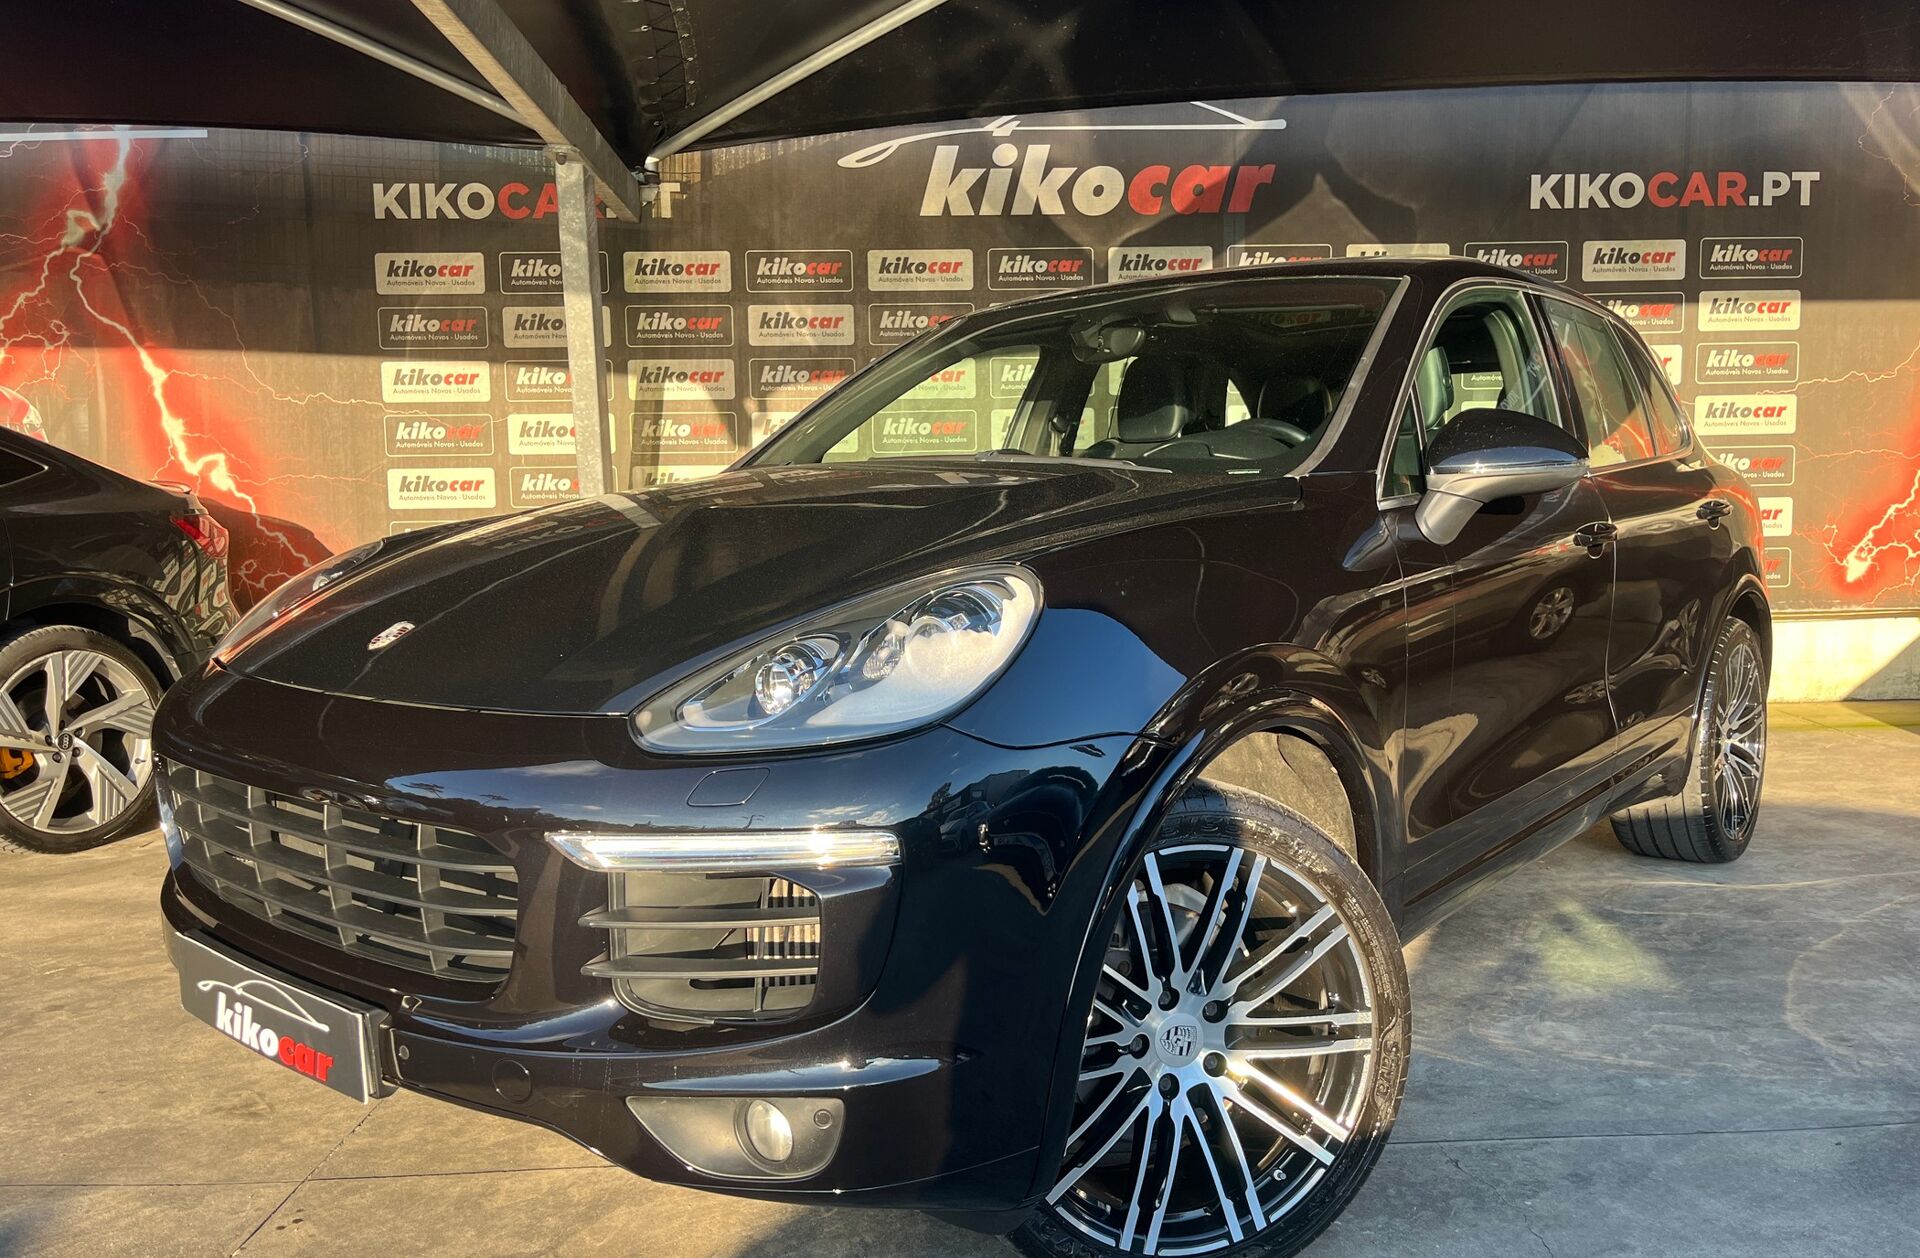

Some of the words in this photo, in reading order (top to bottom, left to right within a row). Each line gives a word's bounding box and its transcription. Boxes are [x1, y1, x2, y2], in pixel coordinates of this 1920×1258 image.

[920, 142, 1276, 216] kikocar
[1530, 171, 1820, 210] KIKOCAR.PT
[372, 182, 681, 220] KIKOCA.T
[1592, 247, 1676, 266] kikocar
[1710, 244, 1793, 262] kikocar
[386, 260, 474, 278] kikocar
[510, 258, 562, 278] kiko
[634, 258, 720, 276] kikocar
[756, 257, 843, 276] kikocar
[878, 256, 964, 274] kikocar
[998, 255, 1084, 274] kikocar
[1118, 254, 1203, 272] kikocar
[1607, 300, 1676, 318] ikocar
[1709, 297, 1792, 316] kikocar
[390, 314, 478, 332] kikocar
[514, 314, 566, 331] kiko
[636, 312, 723, 330] kikocar
[759, 312, 844, 330] kikocar
[1706, 350, 1790, 368] kikocar
[393, 368, 480, 386] kikocar
[516, 367, 572, 386] kiko
[639, 366, 726, 384] kikocar
[554, 386, 574, 394] Novo
[1705, 402, 1788, 418] kikocar
[396, 422, 484, 440] kikocar
[641, 419, 727, 438] kikocar
[882, 417, 968, 436] kikocar
[399, 475, 485, 493] kikocar
[216, 991, 334, 1082] kikocar
